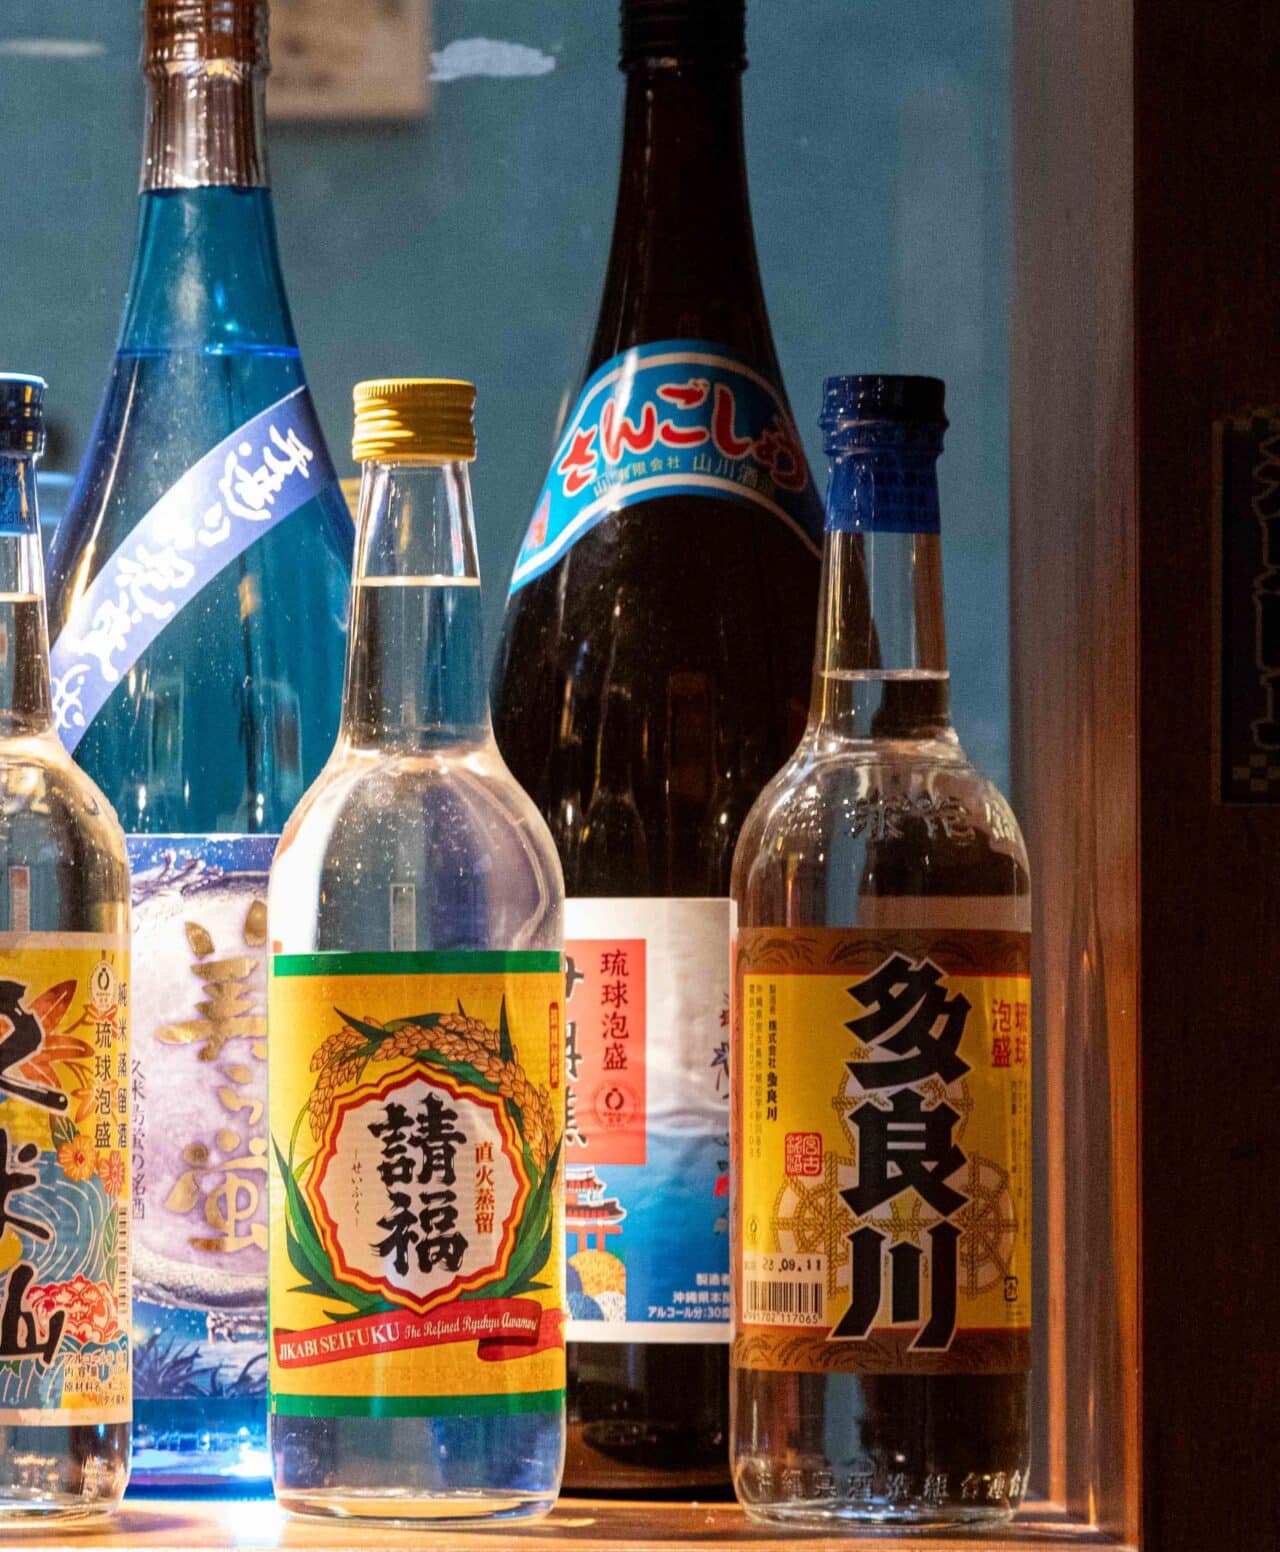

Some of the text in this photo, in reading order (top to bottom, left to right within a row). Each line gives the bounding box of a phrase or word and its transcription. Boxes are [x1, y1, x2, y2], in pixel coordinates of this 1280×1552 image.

[600, 948, 630, 1071] 琉球泡盛
[992, 999, 1011, 1068] 泡盛
[93, 1021, 112, 1148] 琉球泡盛
[367, 1092, 468, 1276] 請福
[474, 1141, 495, 1235] 直火蒸留
[831, 951, 973, 1353] 多良川
[279, 1339, 318, 1361] JIKABI
[320, 1322, 400, 1353] SEIFUKU
[404, 1326, 421, 1340] The
[423, 1318, 461, 1339] Refined
[462, 1313, 501, 1335] Ryukyu
